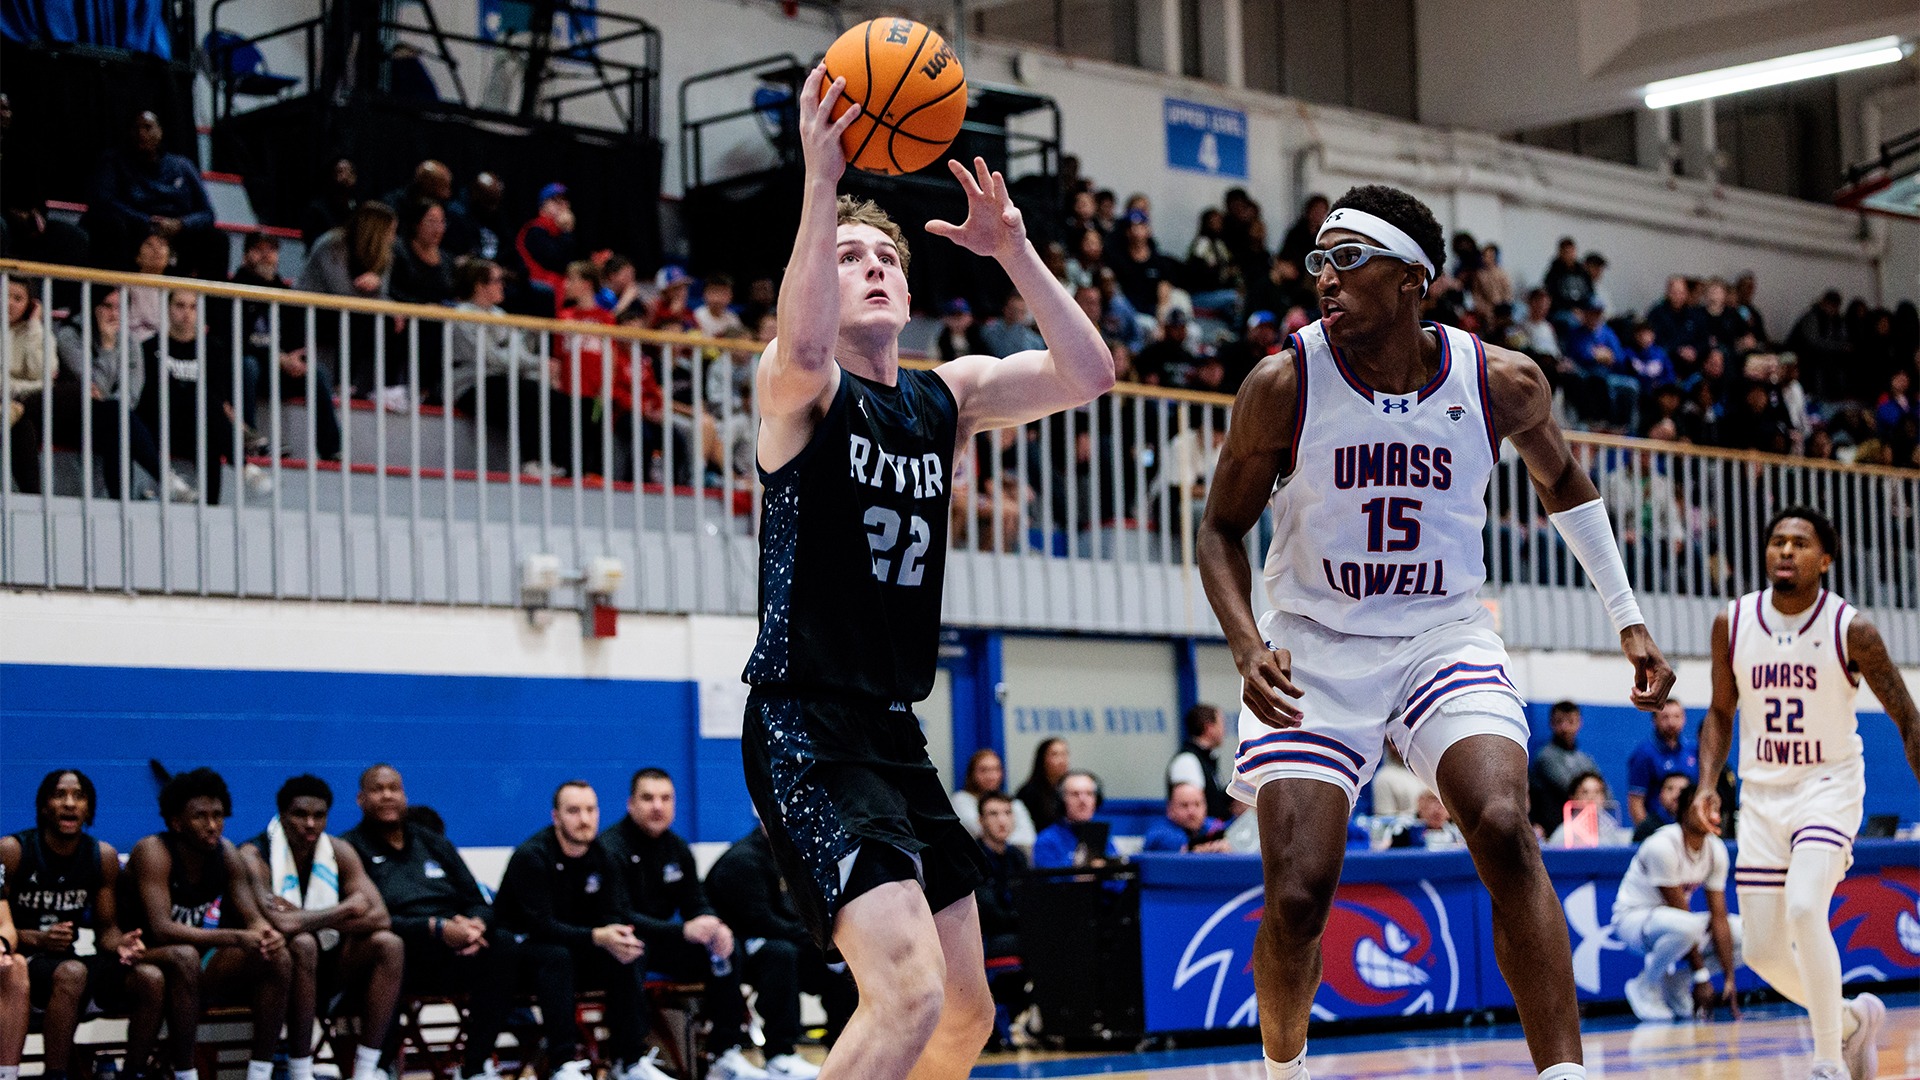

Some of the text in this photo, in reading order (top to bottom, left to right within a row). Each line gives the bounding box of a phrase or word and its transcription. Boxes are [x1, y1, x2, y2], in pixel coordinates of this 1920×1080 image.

[1197, 131, 1221, 171] 4
[1334, 442, 1452, 490] UMASS
[863, 505, 931, 586] 22
[1361, 497, 1423, 553] 15
[1322, 558, 1448, 601] LOWELL
[1752, 663, 1817, 690] UMASS
[1765, 697, 1804, 733] 22
[1756, 737, 1825, 765] LOWELL
